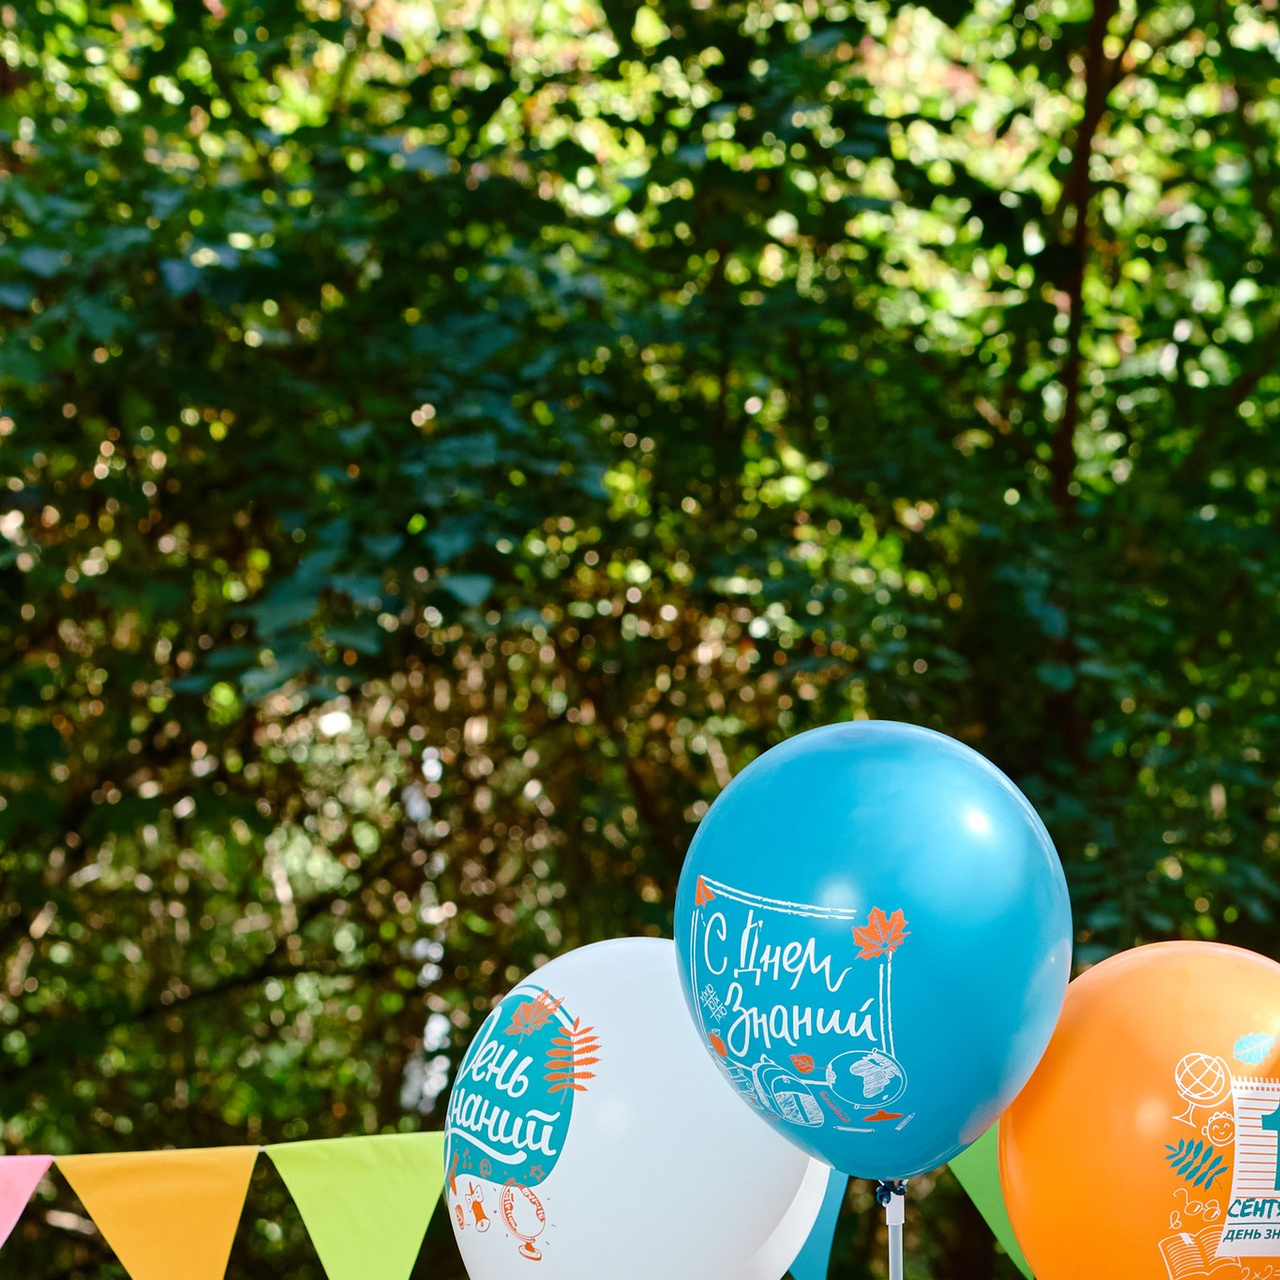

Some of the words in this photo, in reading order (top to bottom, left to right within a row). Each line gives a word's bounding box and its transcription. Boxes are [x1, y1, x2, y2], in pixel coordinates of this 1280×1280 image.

[704, 912, 728, 975] С
[724, 981, 878, 1057] Знаний
[447, 1087, 561, 1156] наний
[1222, 1228, 1262, 1242] ДЕНЬ
